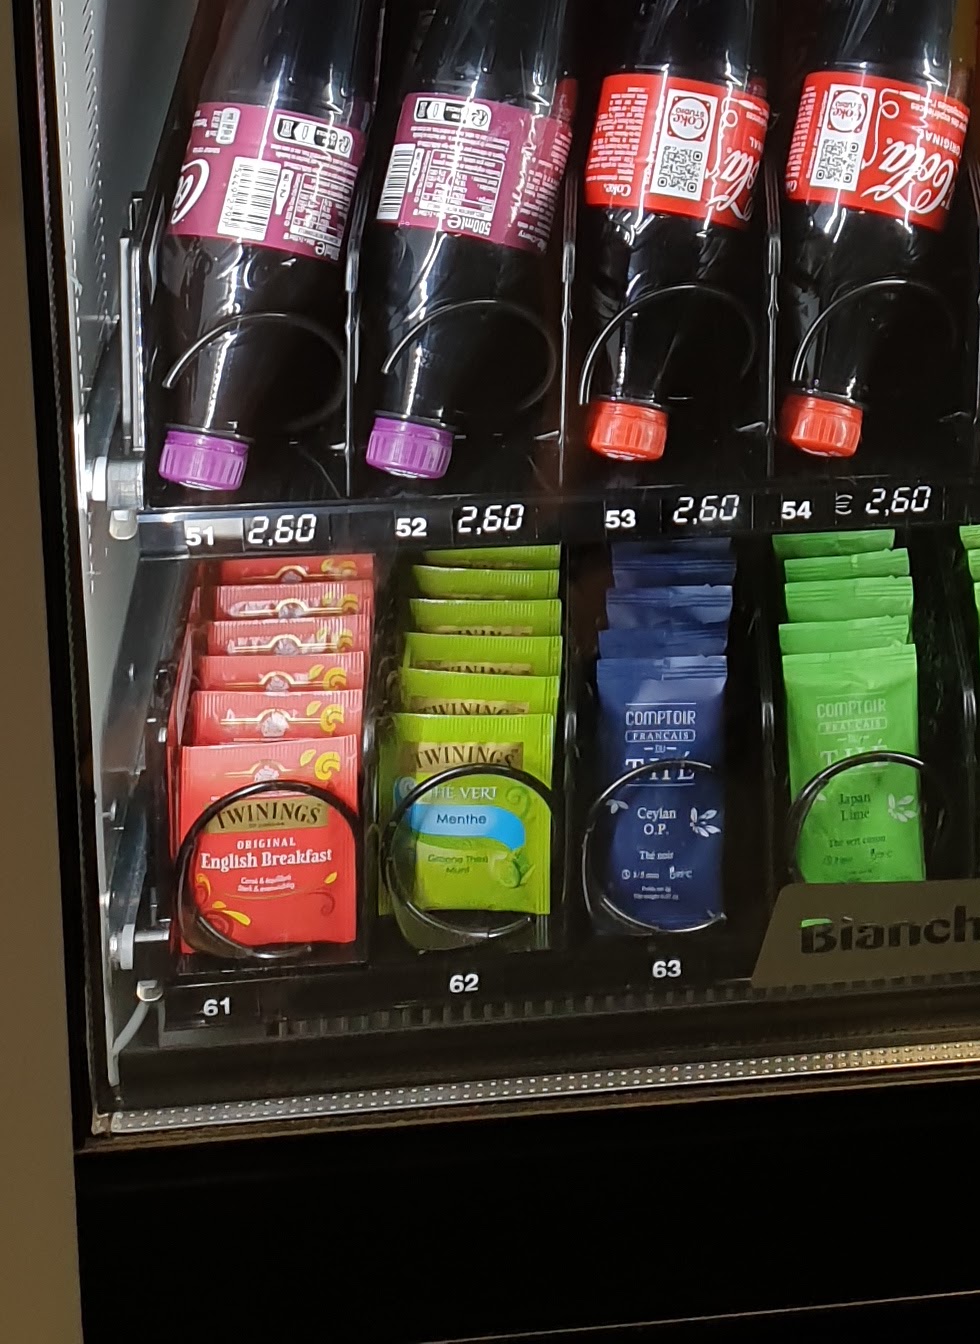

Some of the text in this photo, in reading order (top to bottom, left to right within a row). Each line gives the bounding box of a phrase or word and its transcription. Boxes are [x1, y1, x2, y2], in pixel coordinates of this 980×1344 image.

[671, 114, 705, 130] Coke
[672, 495, 739, 524] 2,60
[865, 485, 932, 516] 2,60
[457, 504, 525, 535] 2,60
[603, 508, 637, 529] 53
[781, 501, 812, 520] 54
[185, 525, 217, 547] 51
[247, 514, 317, 547] 2,60
[395, 516, 428, 537] 52
[625, 710, 697, 726] COMPTOIR
[414, 742, 516, 770] TWININGS
[458, 785, 498, 800] VERT
[839, 792, 872, 807] Japan
[216, 801, 322, 831] TWININGS
[436, 812, 487, 826] Menthe
[637, 808, 677, 822] Ceylan
[840, 809, 870, 823] Lime
[643, 823, 670, 836] O.P.
[236, 836, 297, 850] ORIGINAL
[200, 848, 333, 872] English Breakfast
[652, 960, 682, 979] 63
[449, 974, 479, 993] 62
[203, 998, 232, 1016] 61
